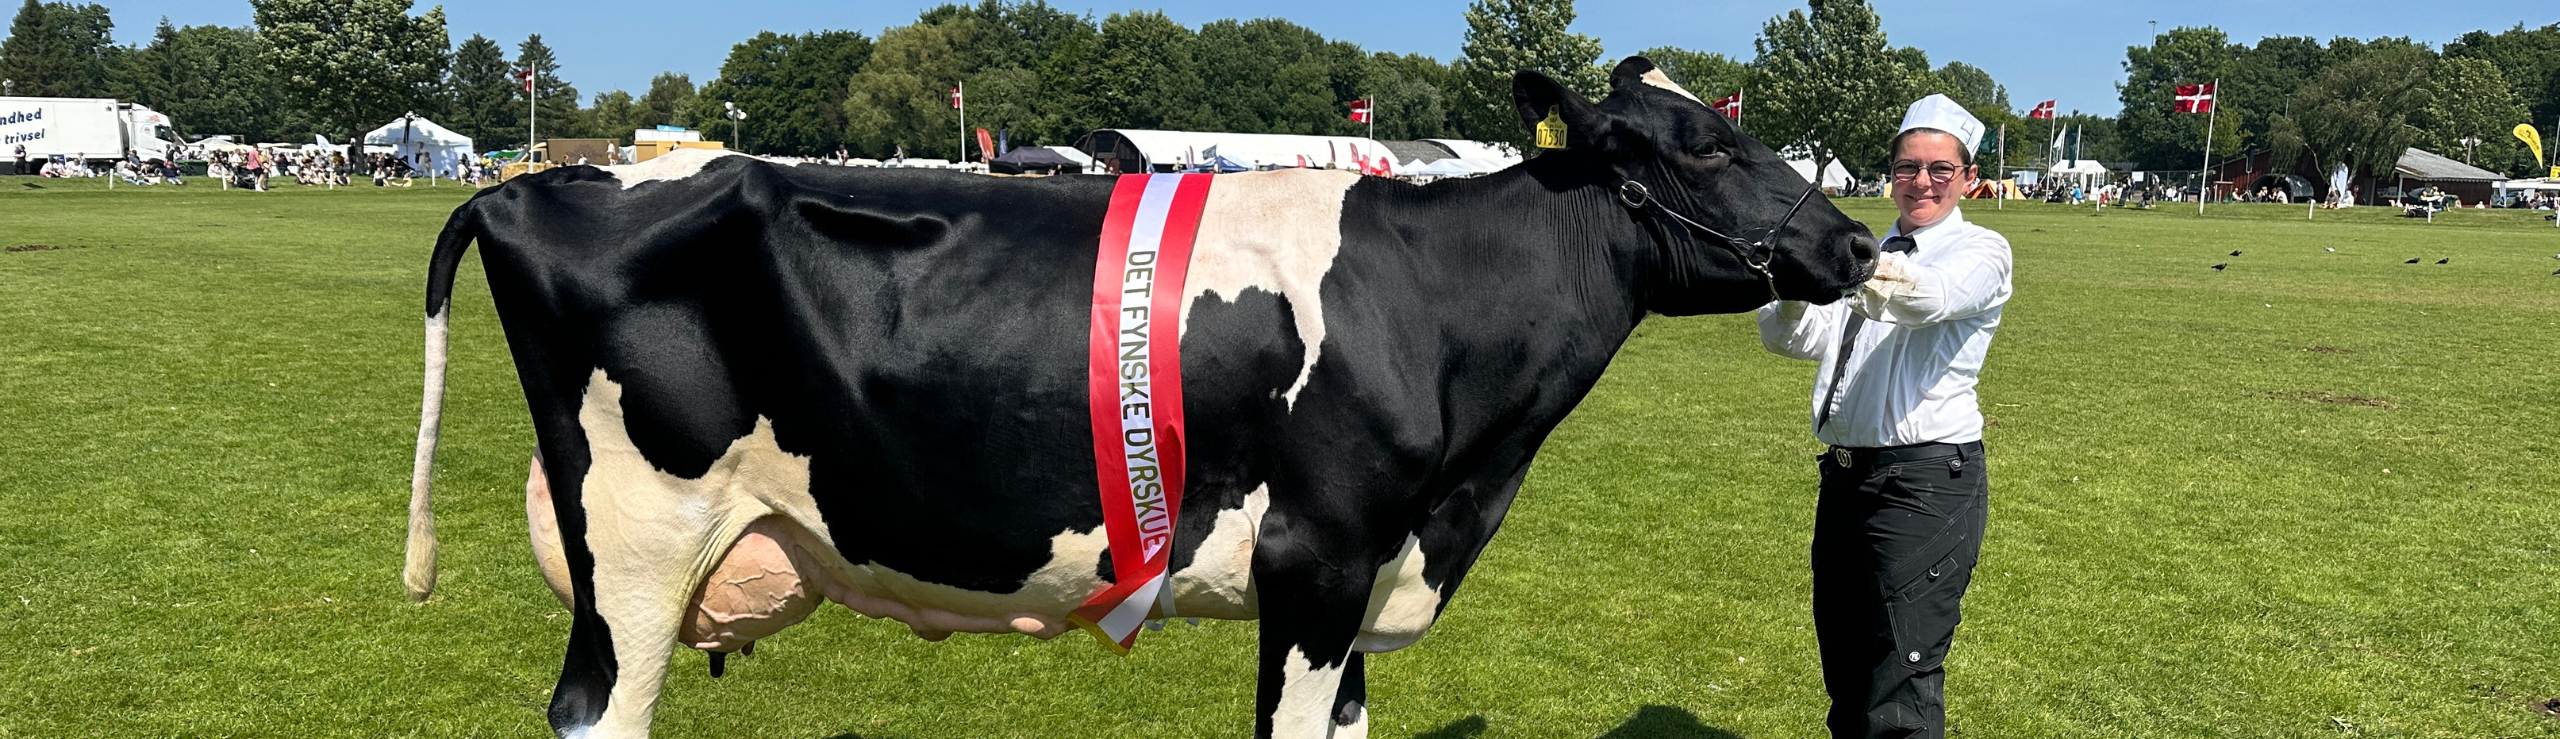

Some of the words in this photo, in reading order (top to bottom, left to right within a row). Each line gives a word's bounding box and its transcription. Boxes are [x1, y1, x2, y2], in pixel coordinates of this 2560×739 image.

[5, 128, 45, 144] trivsel
[1537, 129, 1565, 146] 07530
[1124, 251, 1156, 298] DET
[1120, 306, 1150, 420] FYNSKE
